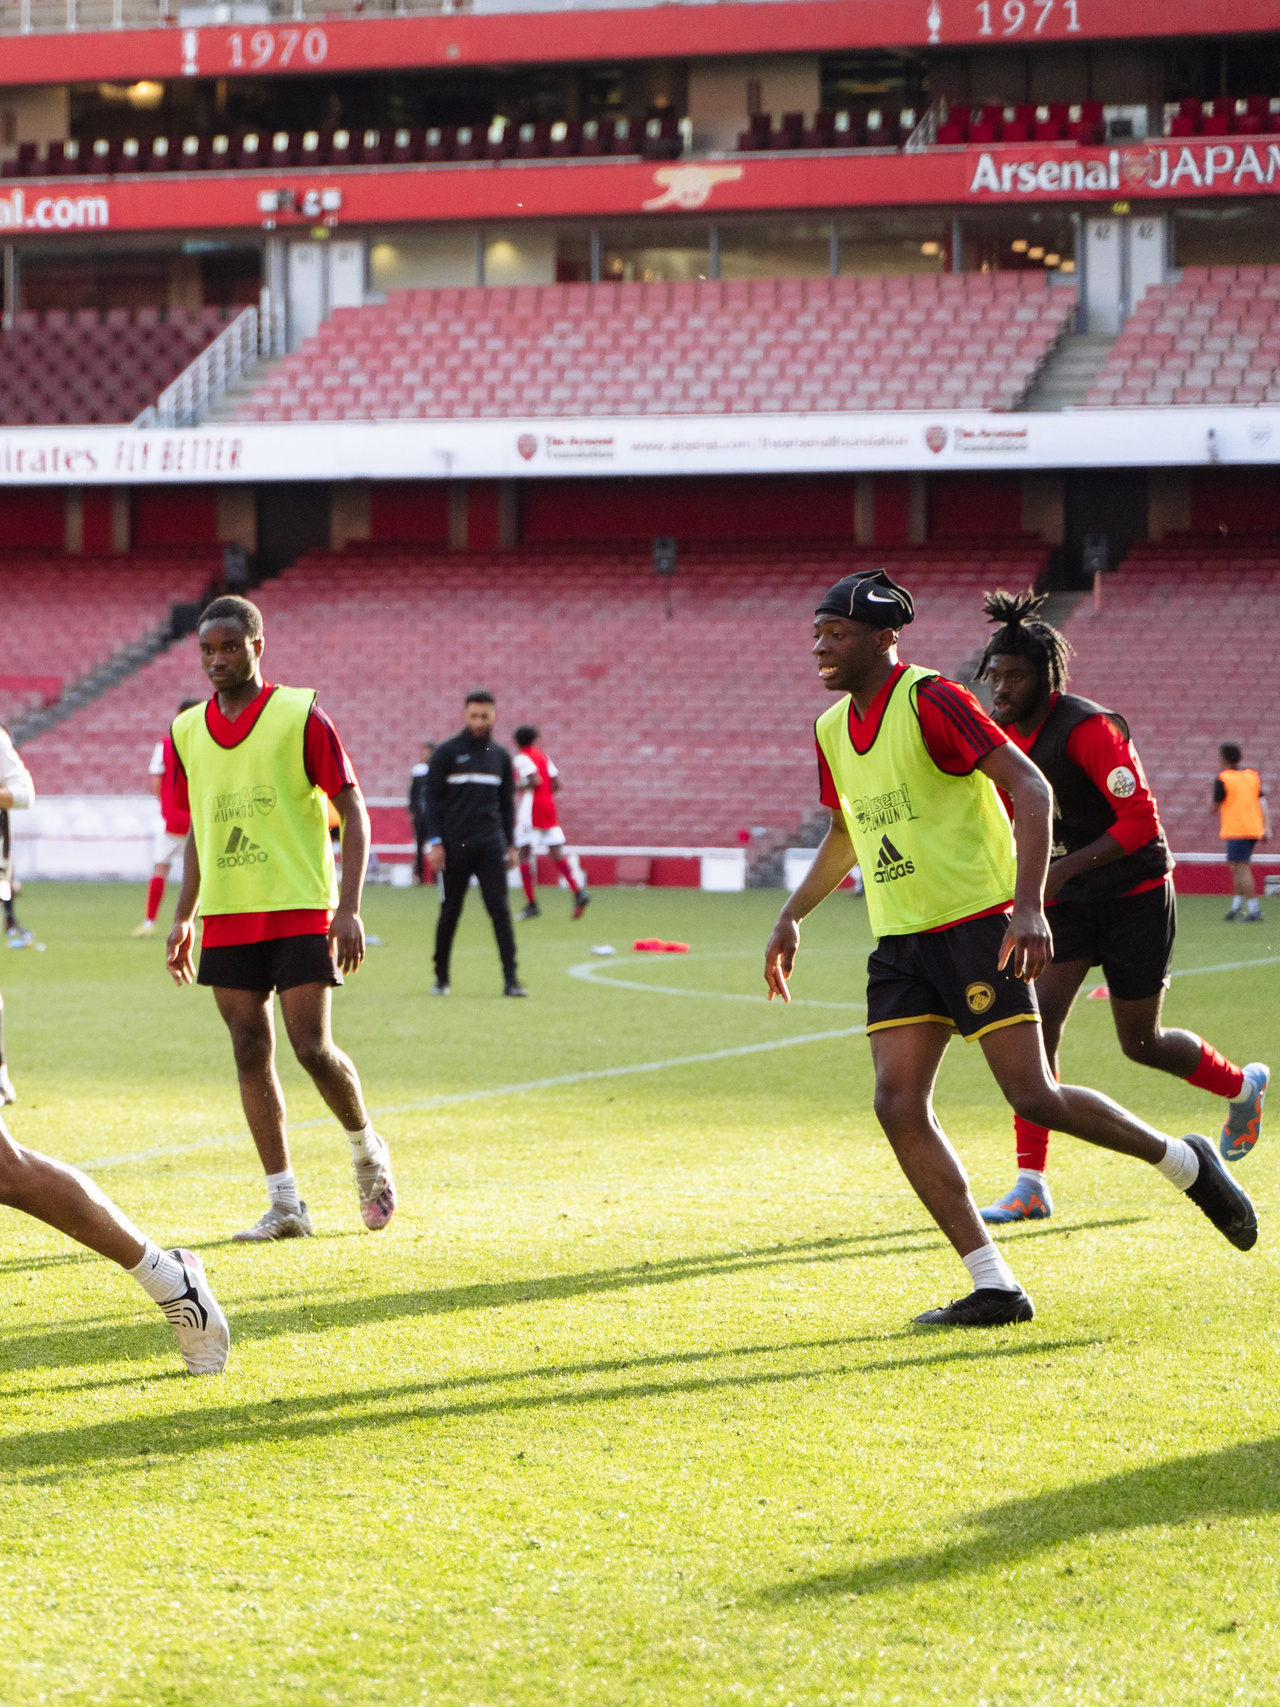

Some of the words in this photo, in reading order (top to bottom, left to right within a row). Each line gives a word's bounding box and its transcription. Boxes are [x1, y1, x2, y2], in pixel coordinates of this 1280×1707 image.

[976, 0, 1080, 36] 1971
[227, 28, 328, 68] 1970
[970, 150, 1120, 193] Arsenal
